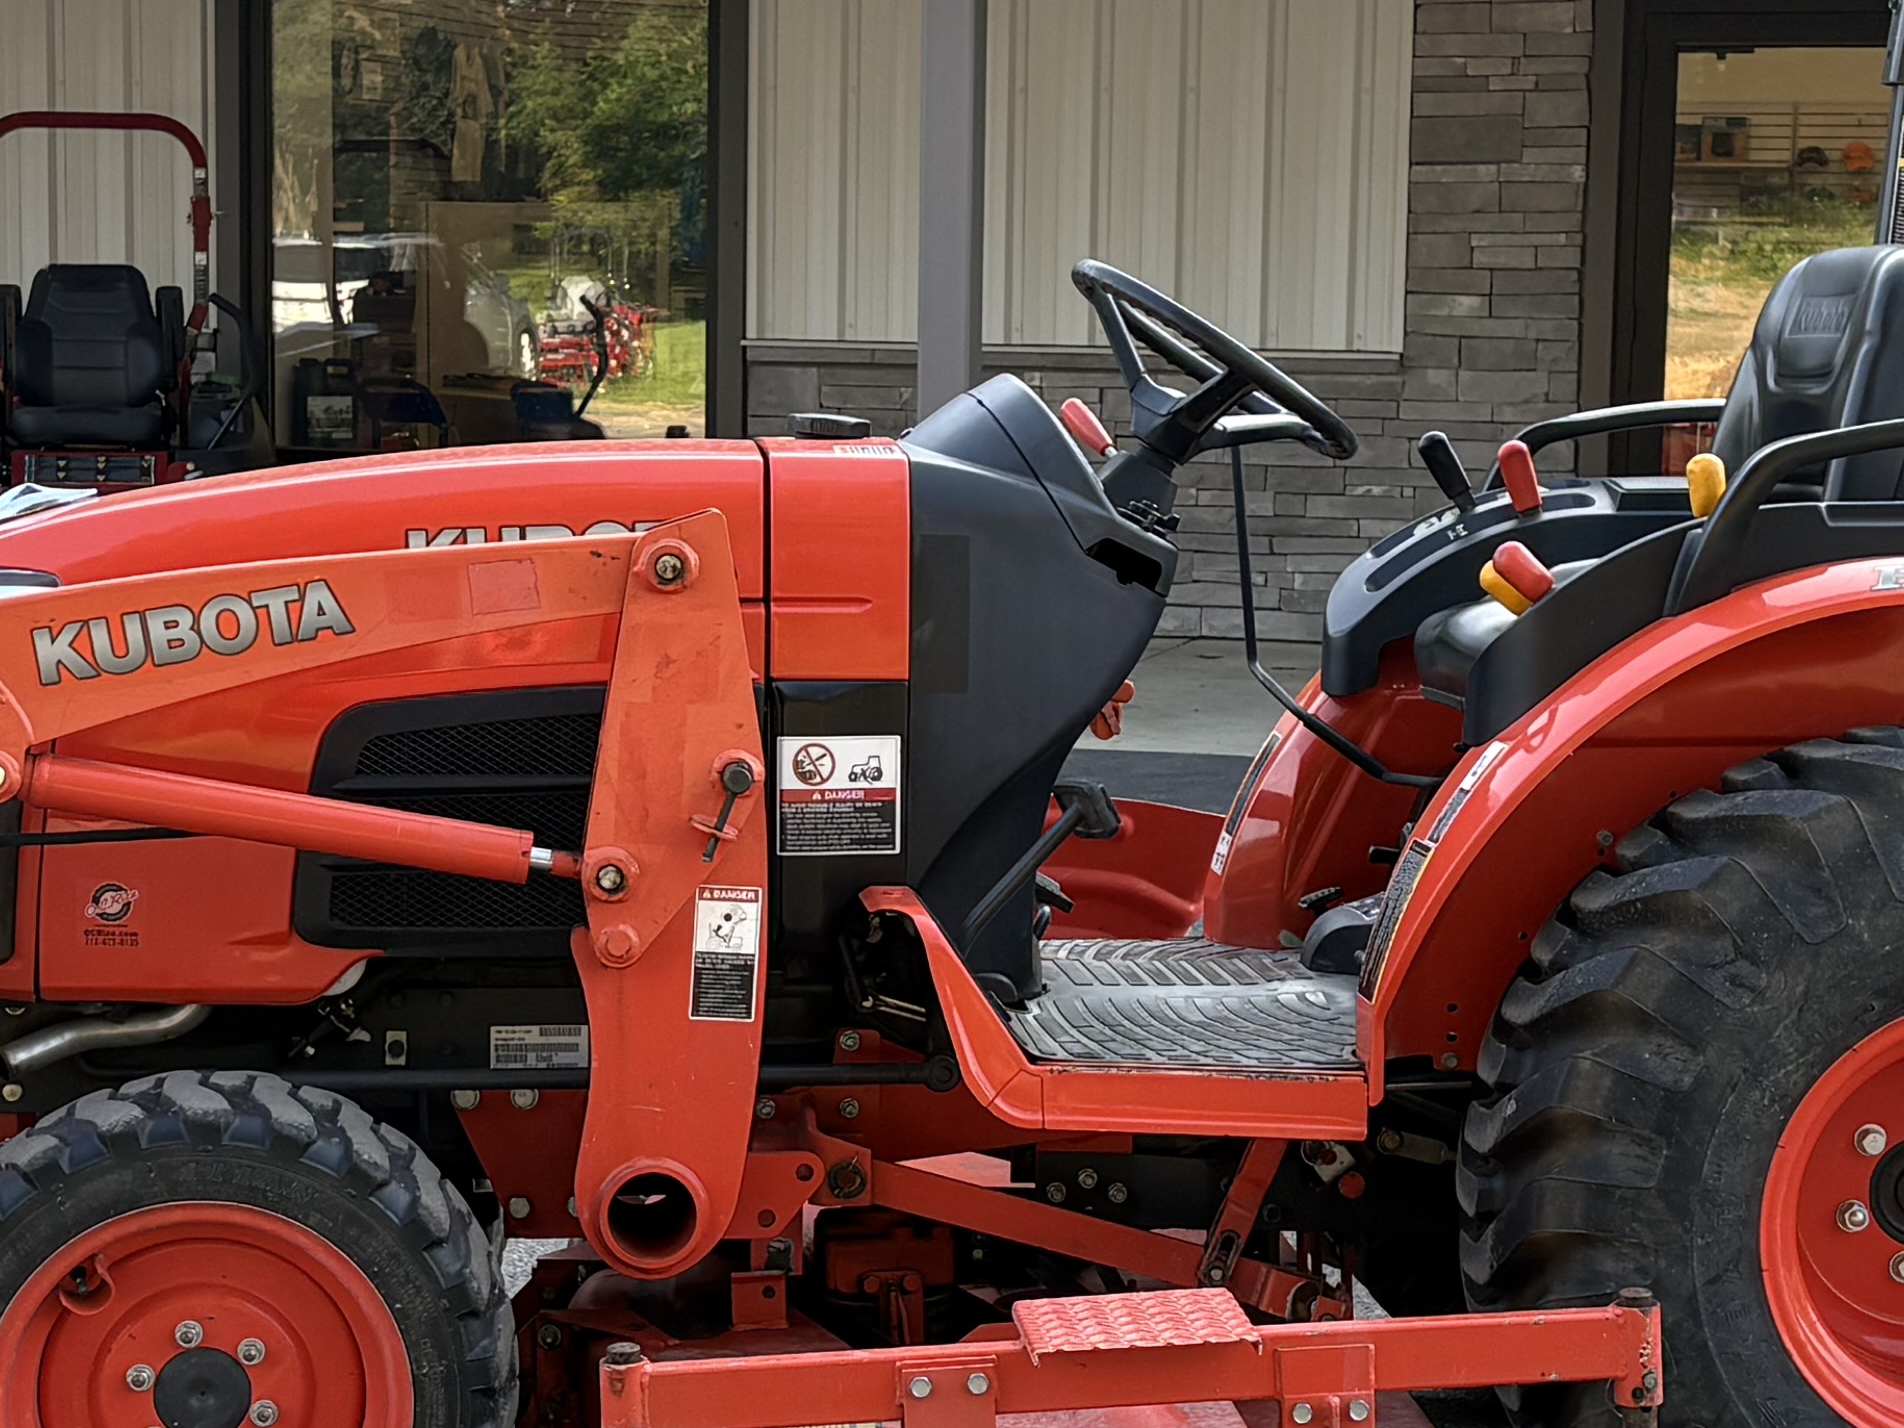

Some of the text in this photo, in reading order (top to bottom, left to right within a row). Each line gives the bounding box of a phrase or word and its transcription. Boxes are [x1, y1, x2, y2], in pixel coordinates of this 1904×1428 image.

[30, 578, 357, 686] KUBOTA
[824, 790, 865, 800] DANGER
[713, 889, 756, 900] DANGER
